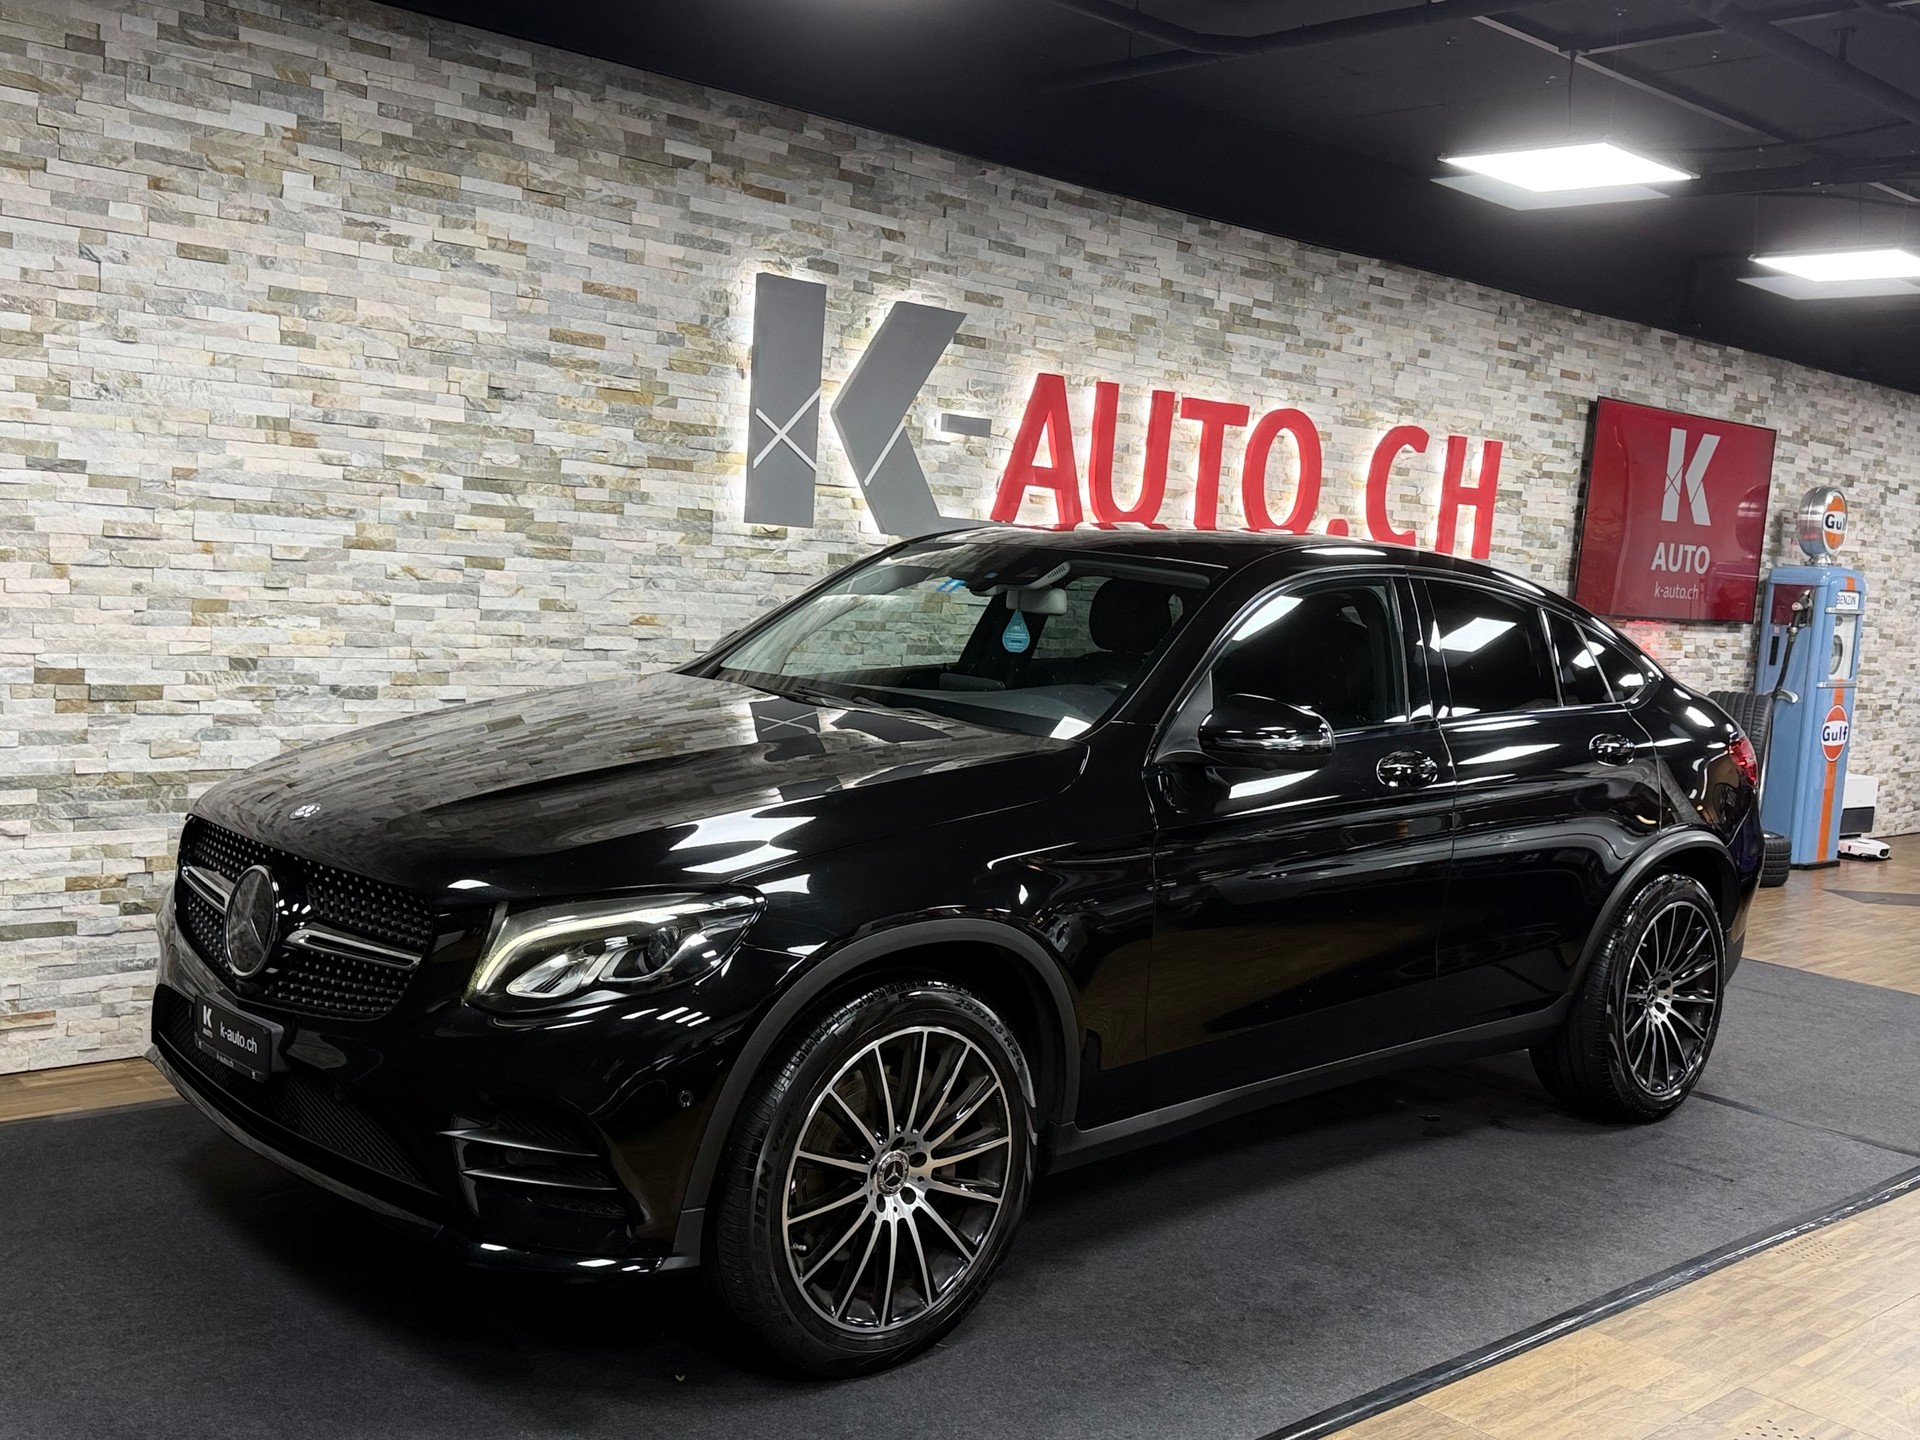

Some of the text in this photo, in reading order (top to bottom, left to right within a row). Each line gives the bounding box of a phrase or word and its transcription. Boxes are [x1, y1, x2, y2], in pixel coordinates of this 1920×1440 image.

[1660, 427, 1721, 526] K
[1825, 513, 1847, 531] Gul
[1651, 541, 1711, 575] AUTO
[1654, 581, 1700, 600] k-auto.ch
[1822, 723, 1849, 743] Gulf
[203, 1004, 213, 1029] K
[220, 1021, 258, 1055] k-auto.ch
